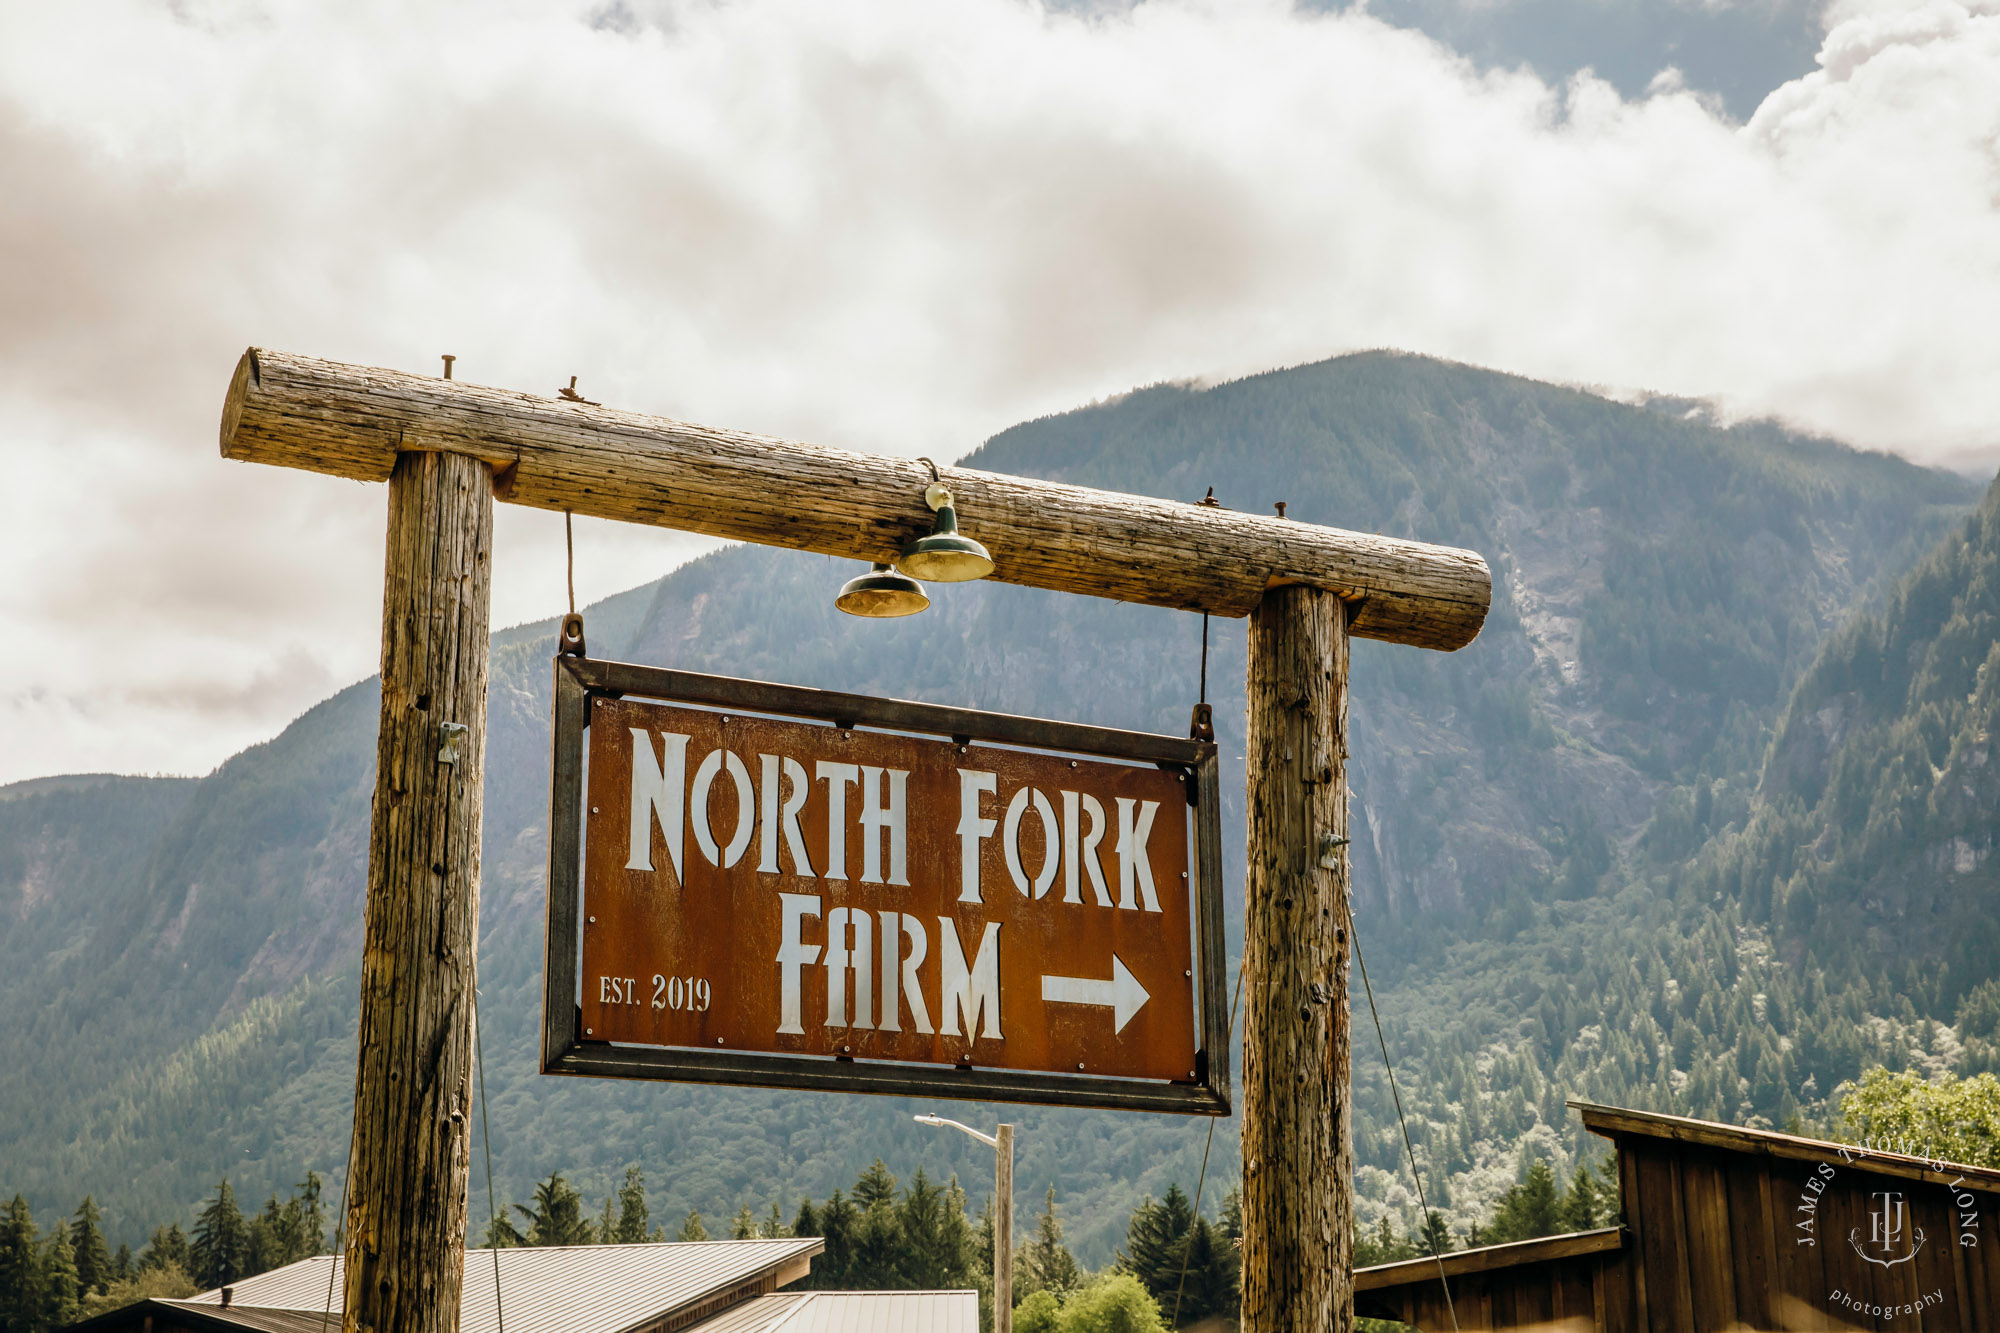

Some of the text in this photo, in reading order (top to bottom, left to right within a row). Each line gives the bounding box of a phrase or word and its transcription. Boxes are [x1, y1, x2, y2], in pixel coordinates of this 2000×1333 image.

[624, 727, 1163, 913] NORTH FORK
[599, 973, 711, 1012] EST. 2019
[775, 892, 1004, 1047] FARM
